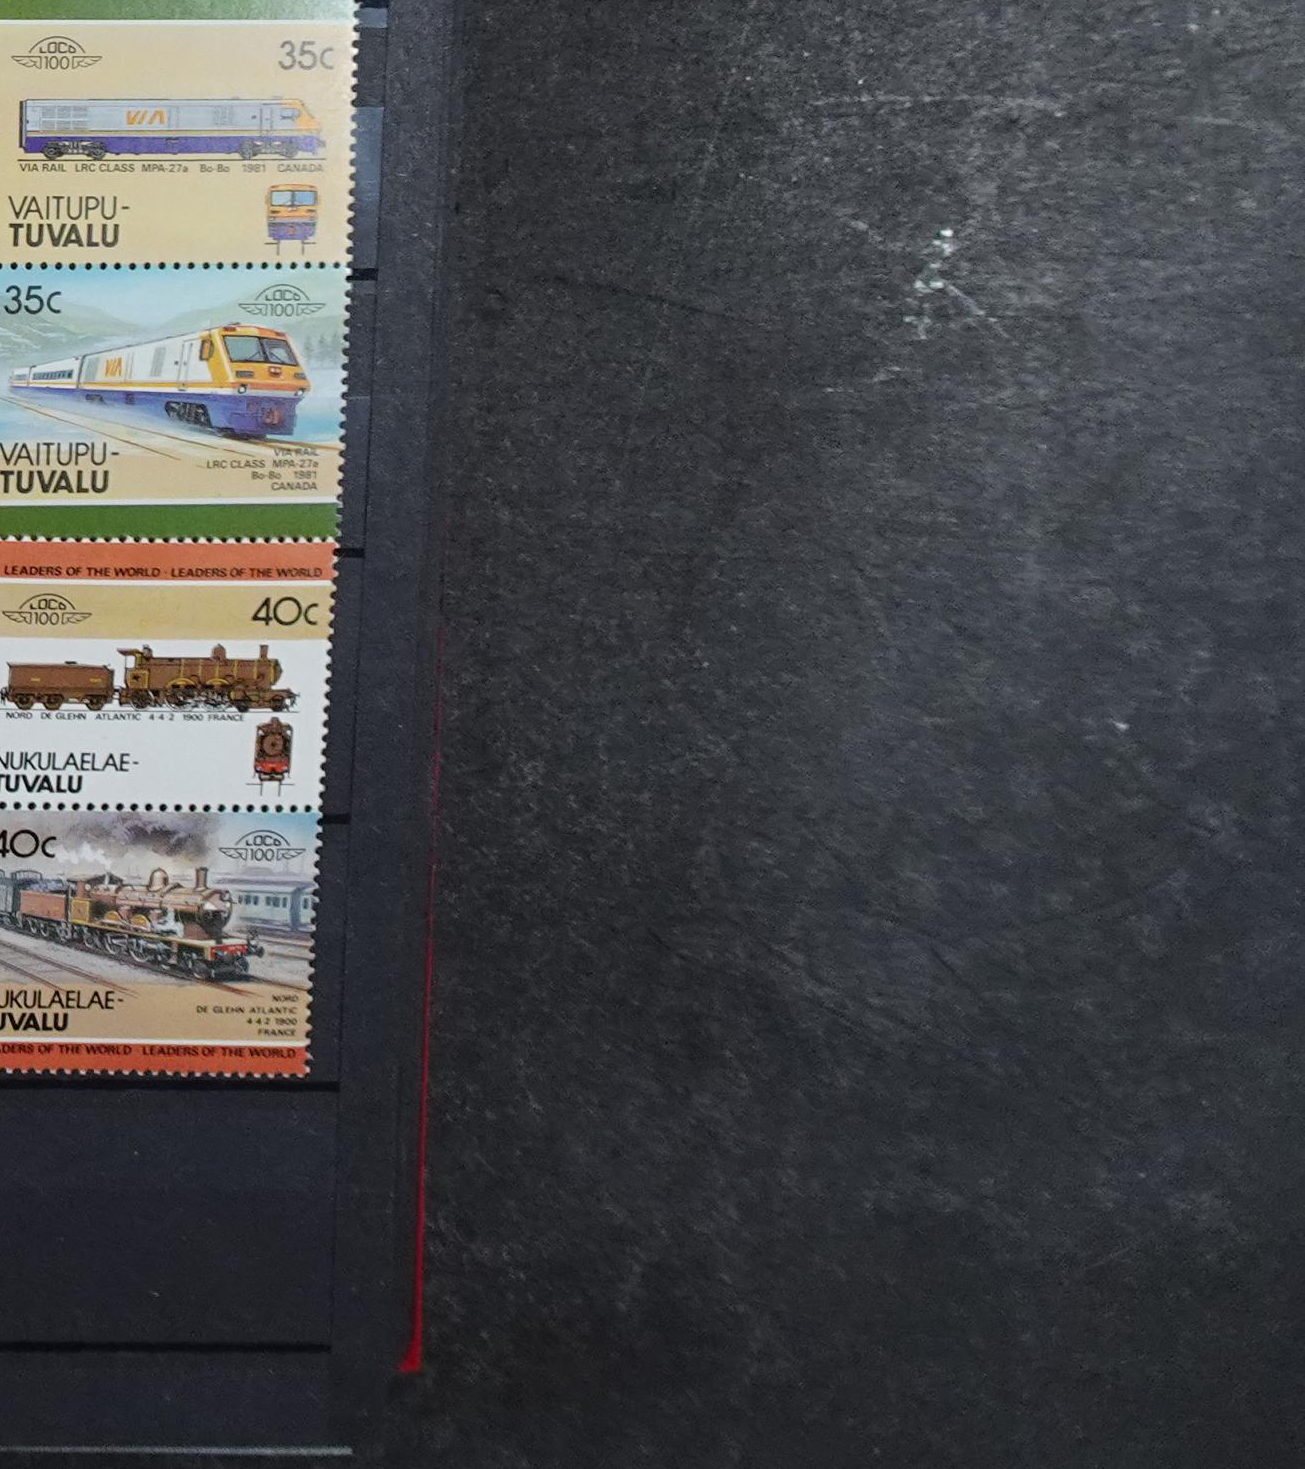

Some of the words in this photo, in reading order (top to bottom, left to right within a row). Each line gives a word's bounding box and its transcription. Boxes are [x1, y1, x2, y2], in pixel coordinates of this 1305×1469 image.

[278, 40, 334, 71] 35c
[19, 163, 39, 173] VIA
[42, 163, 67, 173] RAIL
[98, 163, 135, 173] CLASS
[277, 163, 324, 173] CANADA
[9, 223, 120, 248] TUVALU
[4, 285, 62, 315] 35c
[0, 470, 110, 493] TUVALU
[251, 596, 319, 626] 40c
[207, 713, 245, 722] FRANCE
